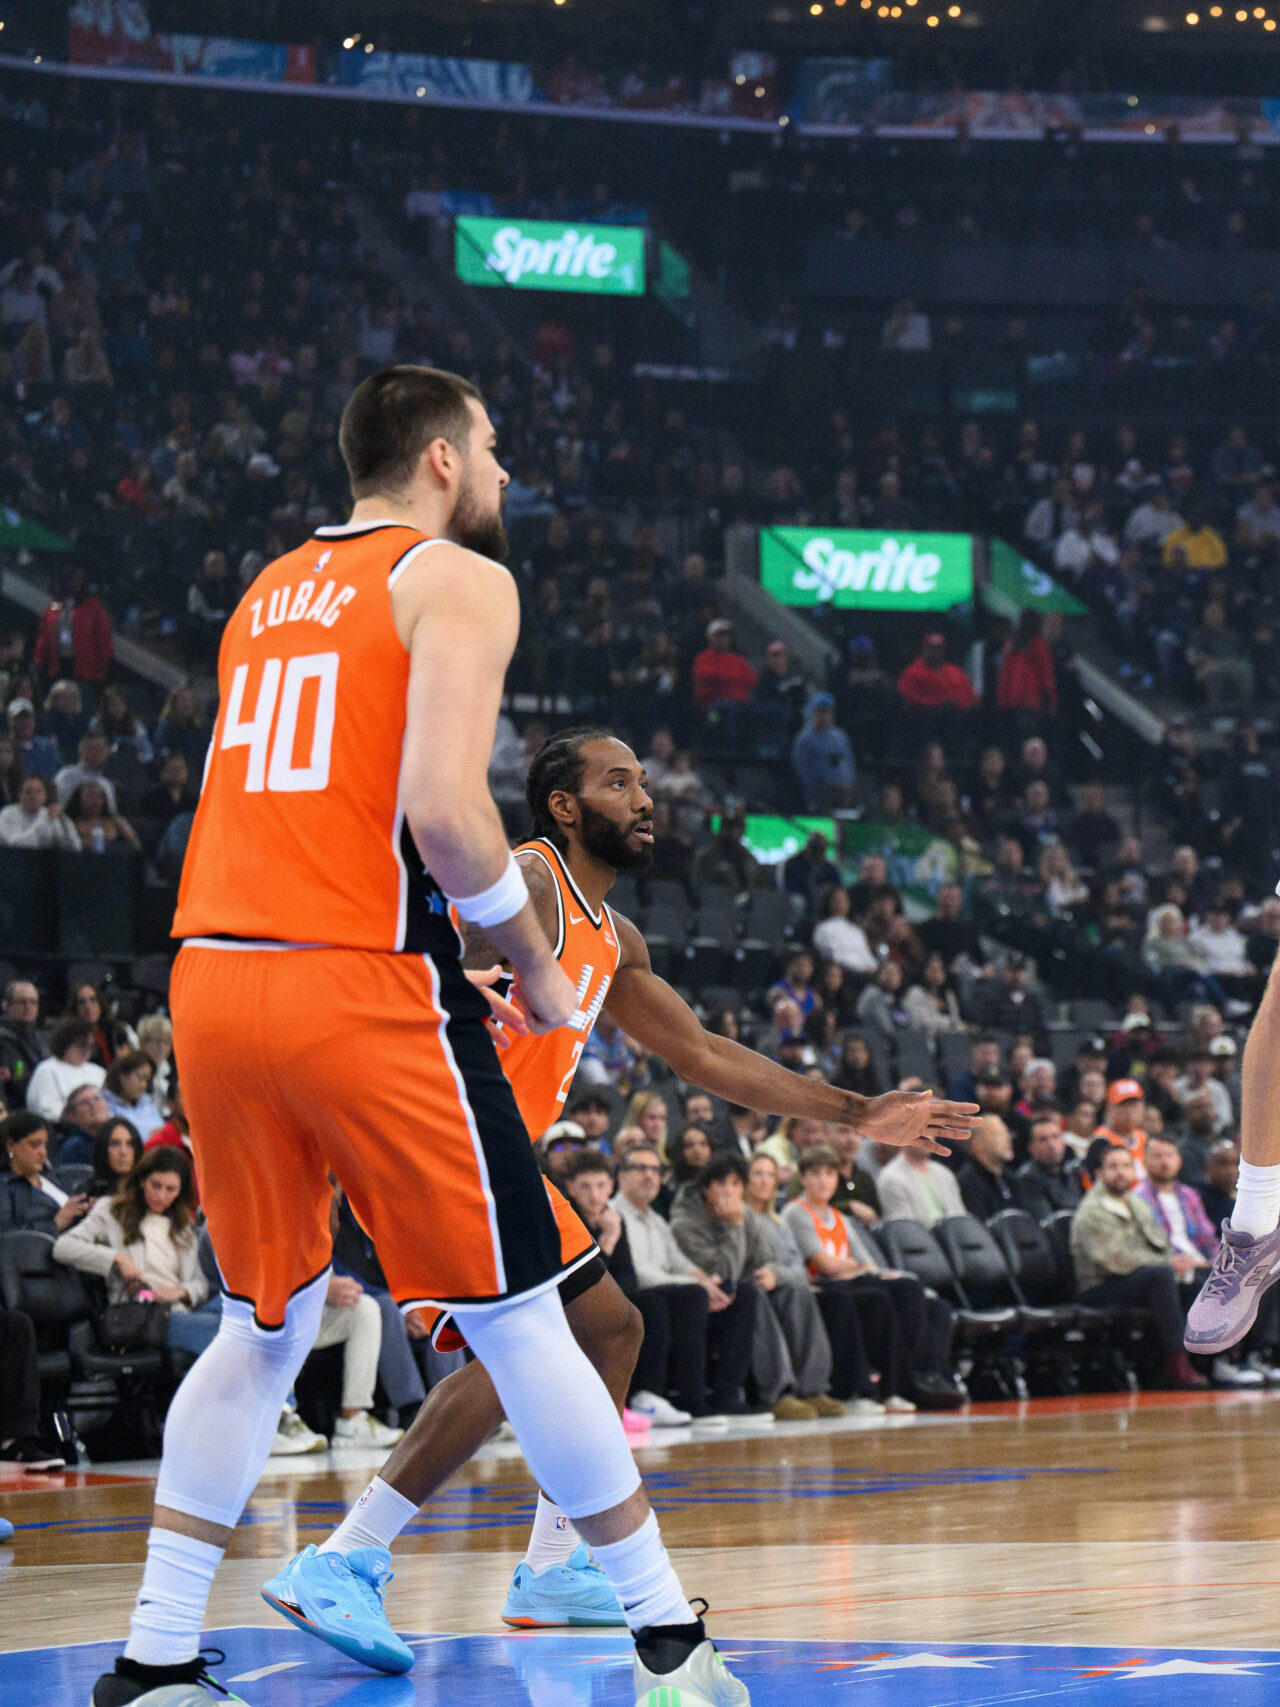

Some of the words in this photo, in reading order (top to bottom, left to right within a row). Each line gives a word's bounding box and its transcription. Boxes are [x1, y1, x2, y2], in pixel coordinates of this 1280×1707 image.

[486, 226, 617, 283] Sprite
[793, 538, 941, 601] Sprite
[221, 652, 340, 792] 40
